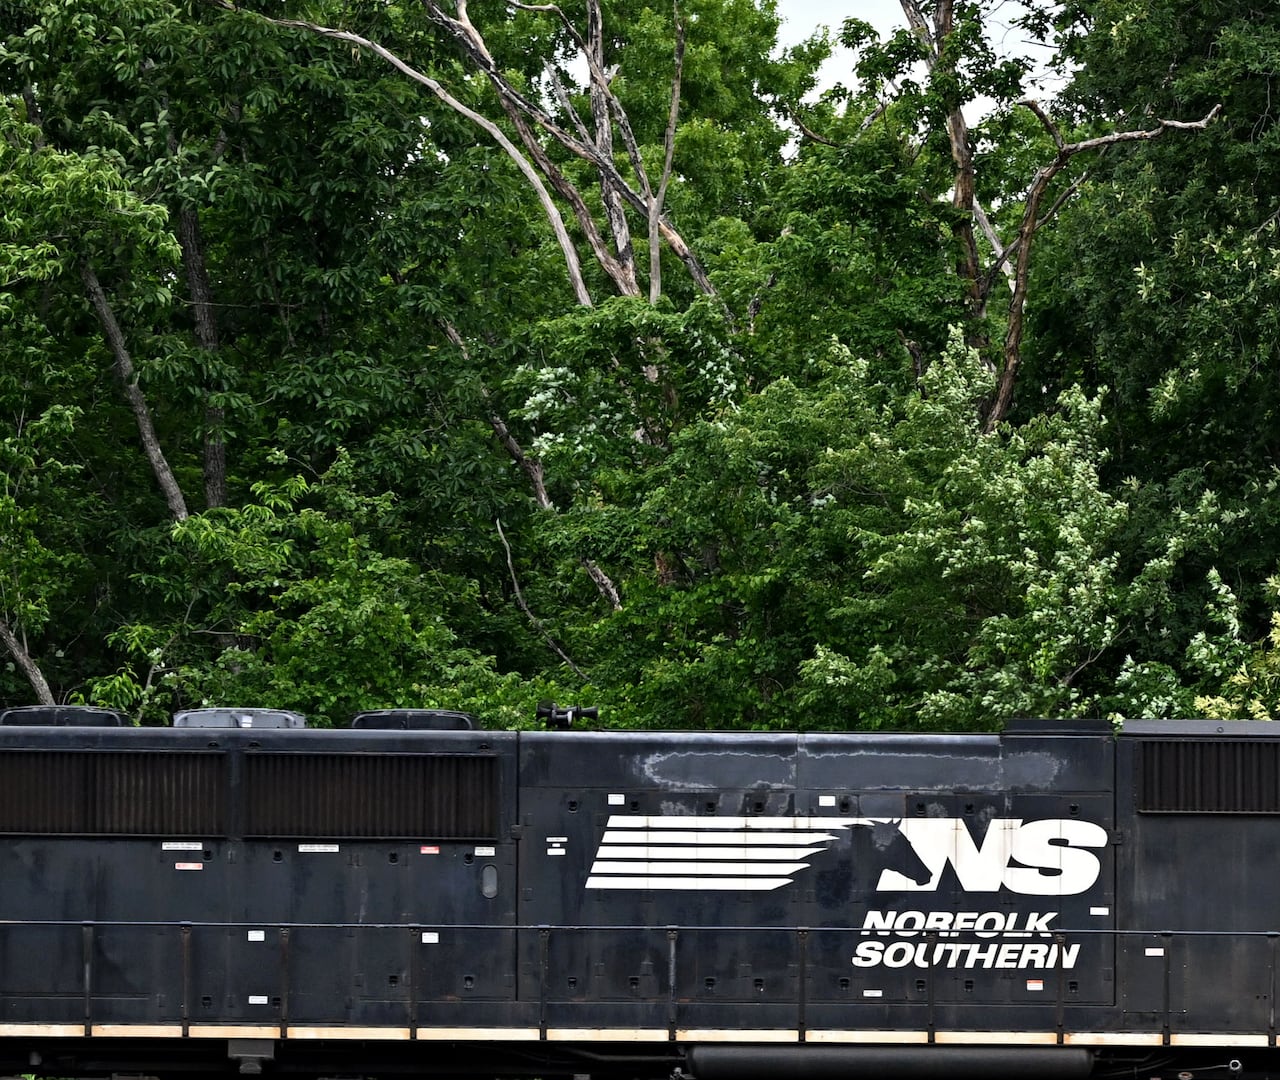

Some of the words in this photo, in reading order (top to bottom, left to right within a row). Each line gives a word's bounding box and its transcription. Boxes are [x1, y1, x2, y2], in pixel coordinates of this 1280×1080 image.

[876, 818, 1109, 896] NS
[860, 910, 1059, 938] NORFOLK
[851, 941, 1081, 969] SOUTHERN
